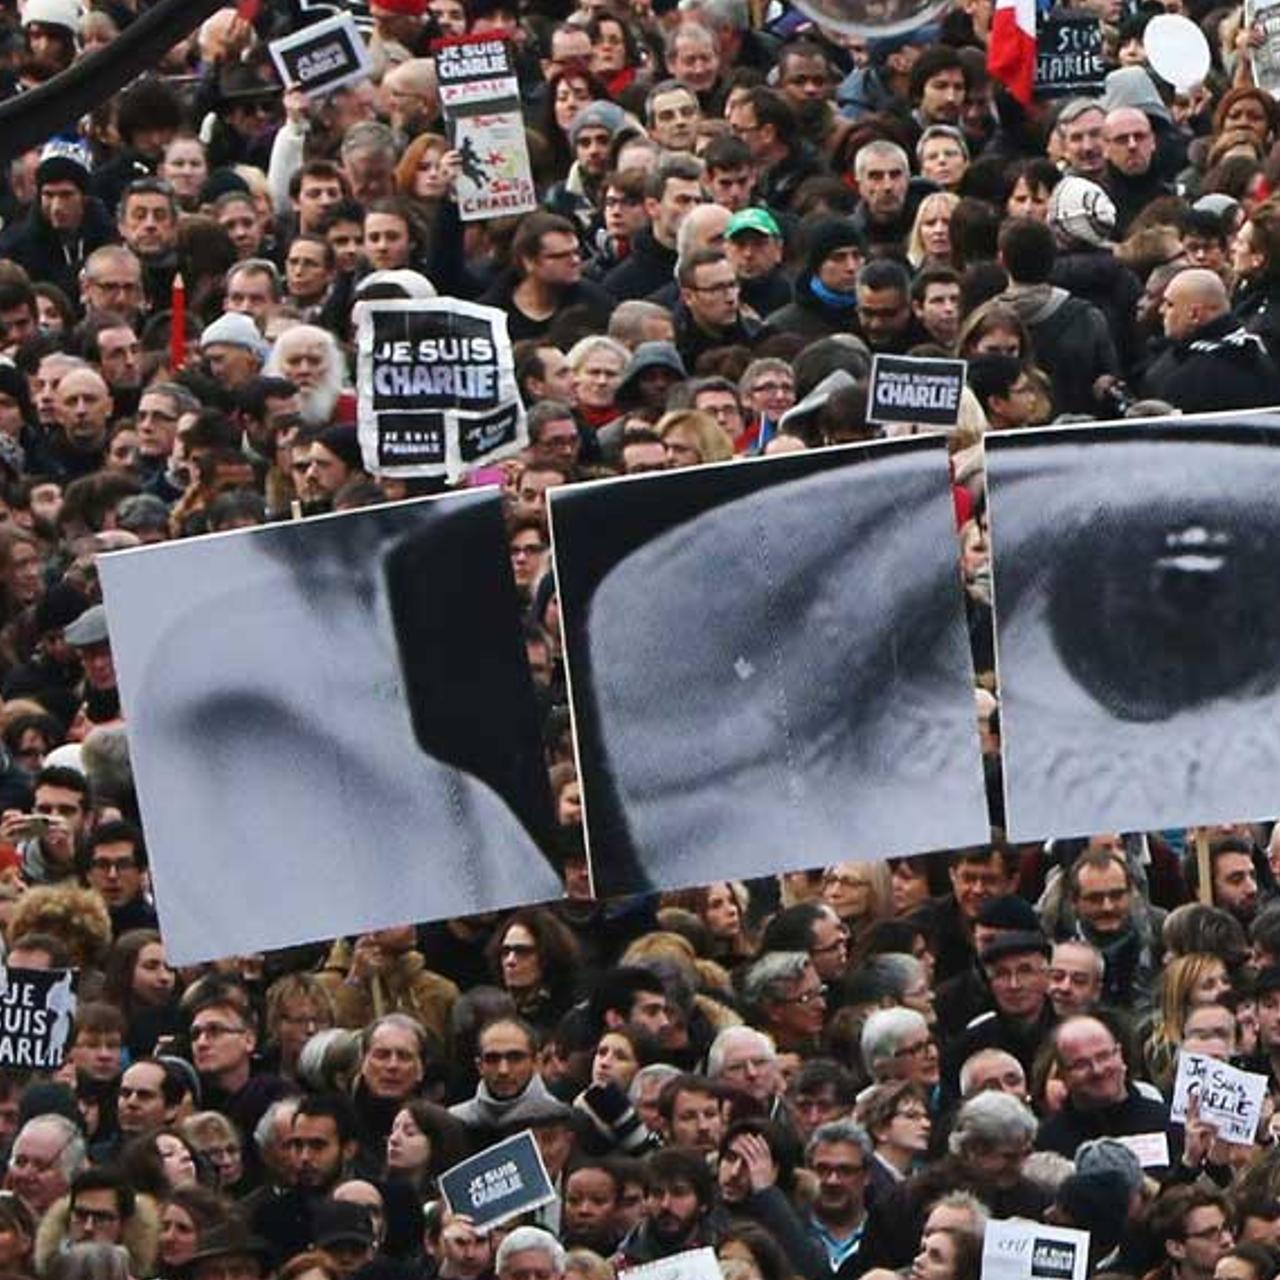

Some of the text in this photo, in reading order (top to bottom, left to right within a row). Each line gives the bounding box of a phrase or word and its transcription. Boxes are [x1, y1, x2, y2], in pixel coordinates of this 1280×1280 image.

[373, 337, 495, 365] JE SUIS
[372, 363, 500, 401] CHARLIE
[876, 381, 958, 410] CHARLIE
[3, 983, 35, 1007] JE
[471, 1173, 525, 1208] CHARLIE
